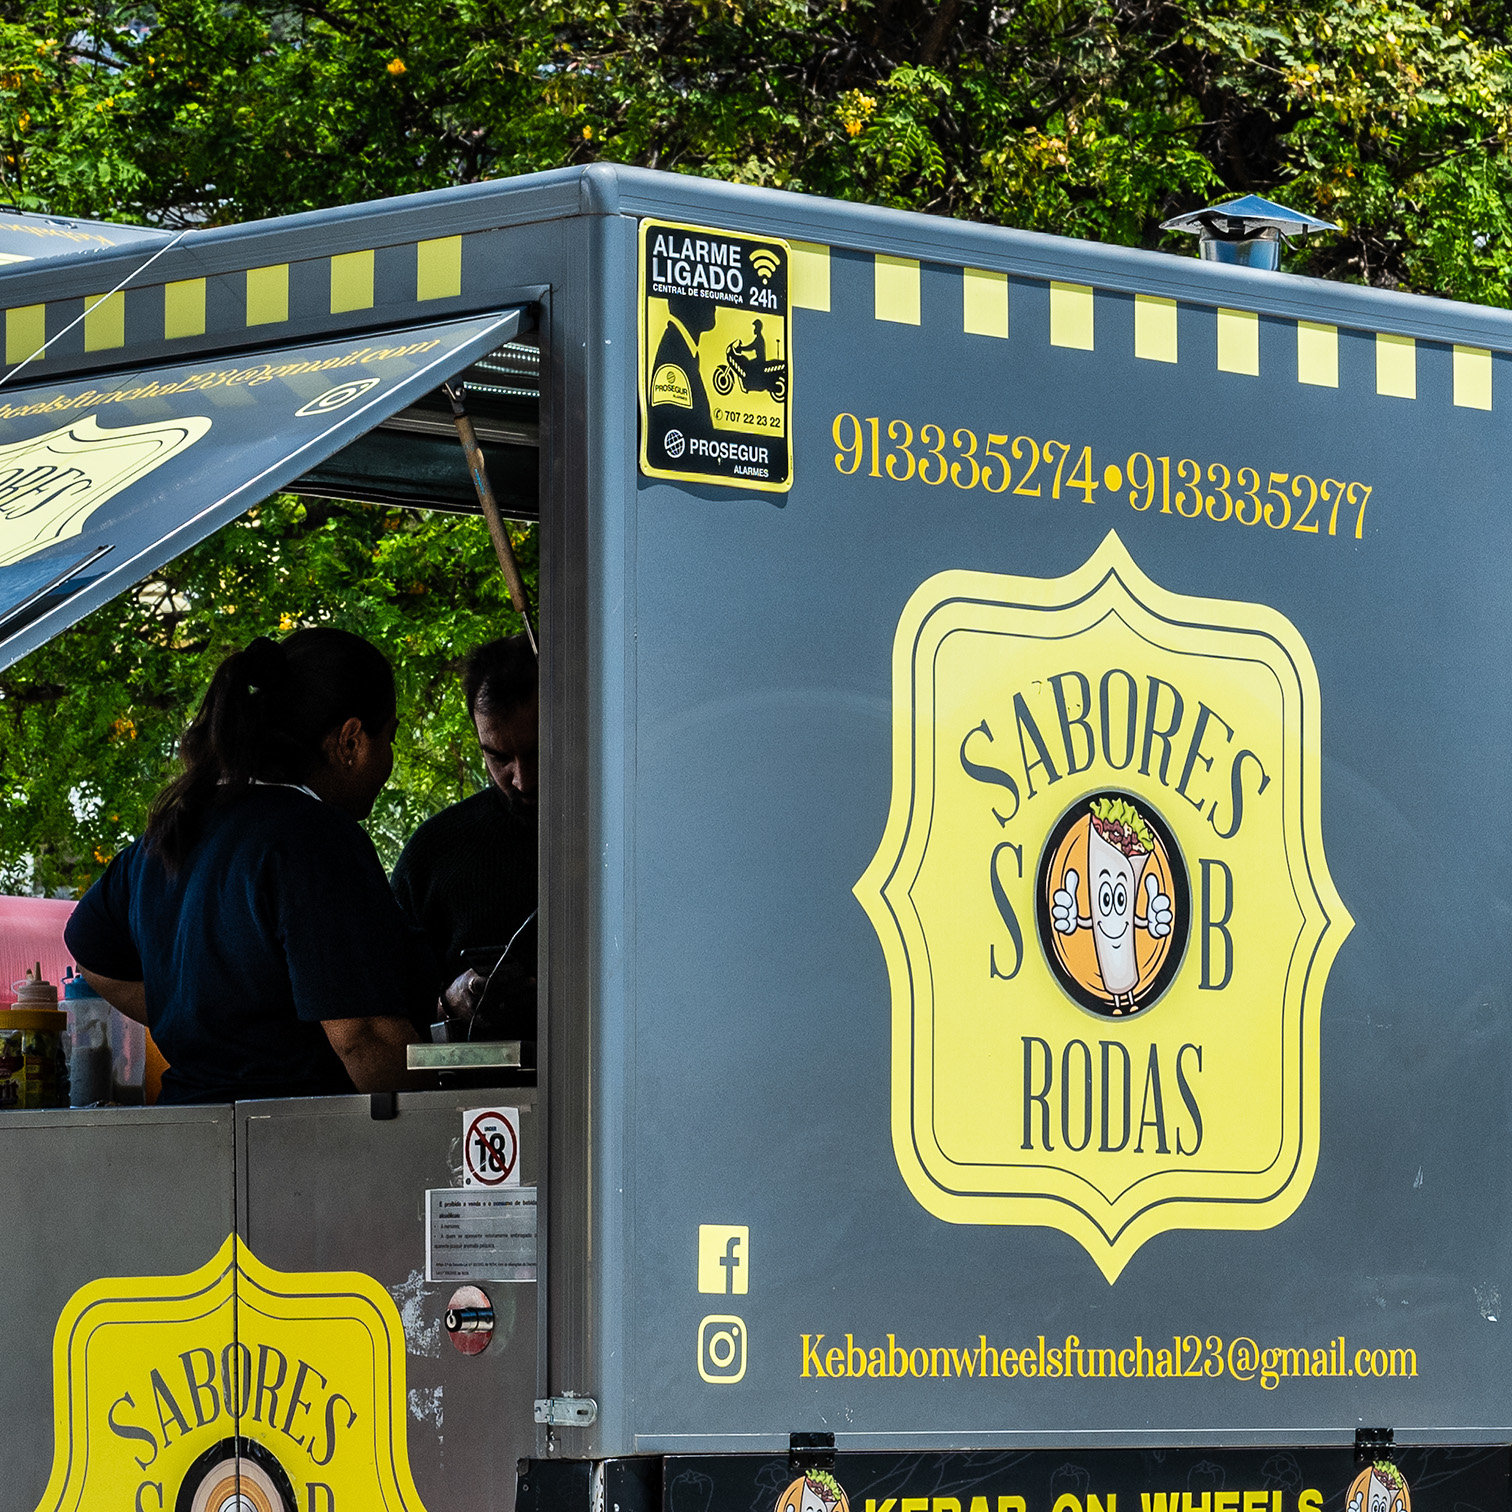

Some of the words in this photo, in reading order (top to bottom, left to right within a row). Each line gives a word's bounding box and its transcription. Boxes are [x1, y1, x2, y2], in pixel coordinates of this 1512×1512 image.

[652, 234, 742, 269] ALARME
[652, 257, 744, 293] LIGADO
[749, 287, 778, 310] 24h
[652, 283, 687, 296] CENTRAL
[688, 288, 699, 297] DE
[699, 289, 744, 304] SEGURANÇA
[724, 410, 742, 423] 707
[743, 412, 755, 424] 22
[757, 414, 769, 425] 23
[770, 416, 781, 428] 22
[690, 438, 769, 464] PROSEGUR
[733, 464, 769, 478] ALARMES
[958, 667, 1272, 841] SABORES
[1020, 1035, 1204, 1157] RODAS
[474, 1132, 506, 1173] 18
[798, 1332, 1419, 1391] Kebabonwheelsfunchal23@gmail.com
[107, 1341, 358, 1471] SABORES
